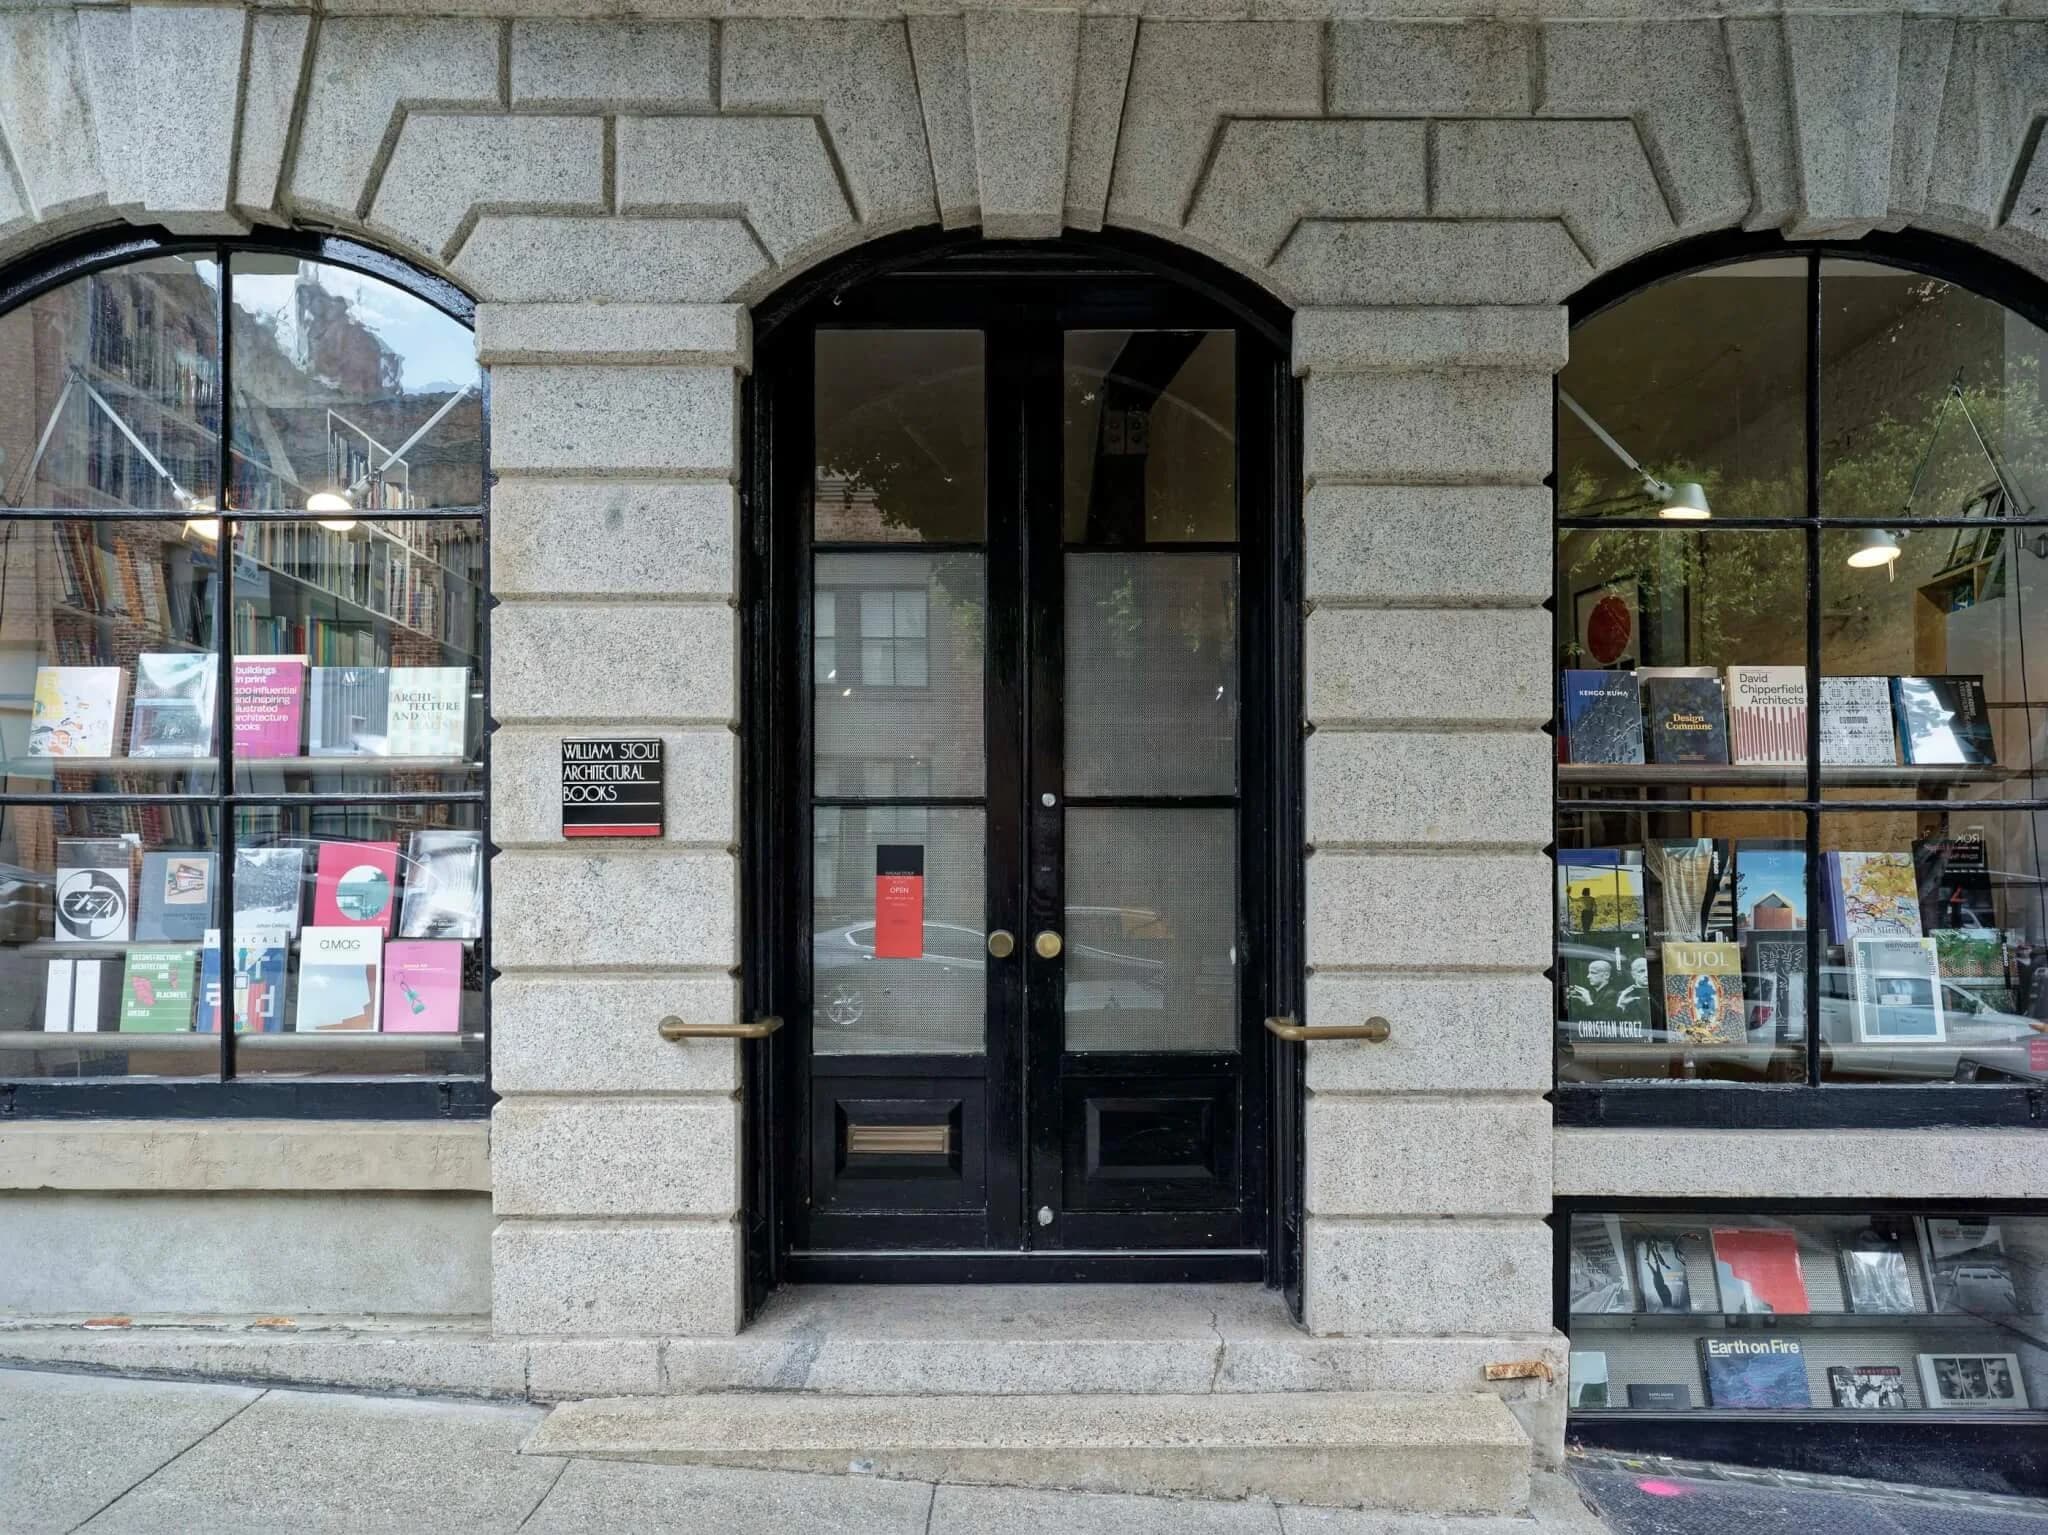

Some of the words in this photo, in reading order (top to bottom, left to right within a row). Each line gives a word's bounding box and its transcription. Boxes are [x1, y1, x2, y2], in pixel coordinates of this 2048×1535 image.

[235, 666, 277, 676] buildings
[244, 676, 266, 685] print
[1739, 673, 1768, 683] David
[253, 686, 297, 694] influential
[1606, 690, 1629, 698] KUMA
[1740, 684, 1804, 696] Chipperfield
[253, 695, 290, 705] inspiring
[1750, 695, 1805, 704] Architects
[408, 702, 460, 711] TECTURE
[393, 711, 419, 721] AND
[1673, 713, 1704, 723] Design
[1665, 721, 1713, 730] Commune
[563, 743, 614, 759] WILLIAM
[620, 743, 659, 759] STOUT
[563, 764, 645, 780] ARCHITECTURAL
[563, 785, 618, 801] BOOKS
[1677, 951, 1729, 969] JUJOL
[1578, 1020, 1617, 1038] CHRISTIAN
[1619, 1020, 1643, 1038] KEREZ
[1708, 1339, 1750, 1354] Earth
[1751, 1342, 1770, 1354] on
[1770, 1339, 1800, 1354] Fire
